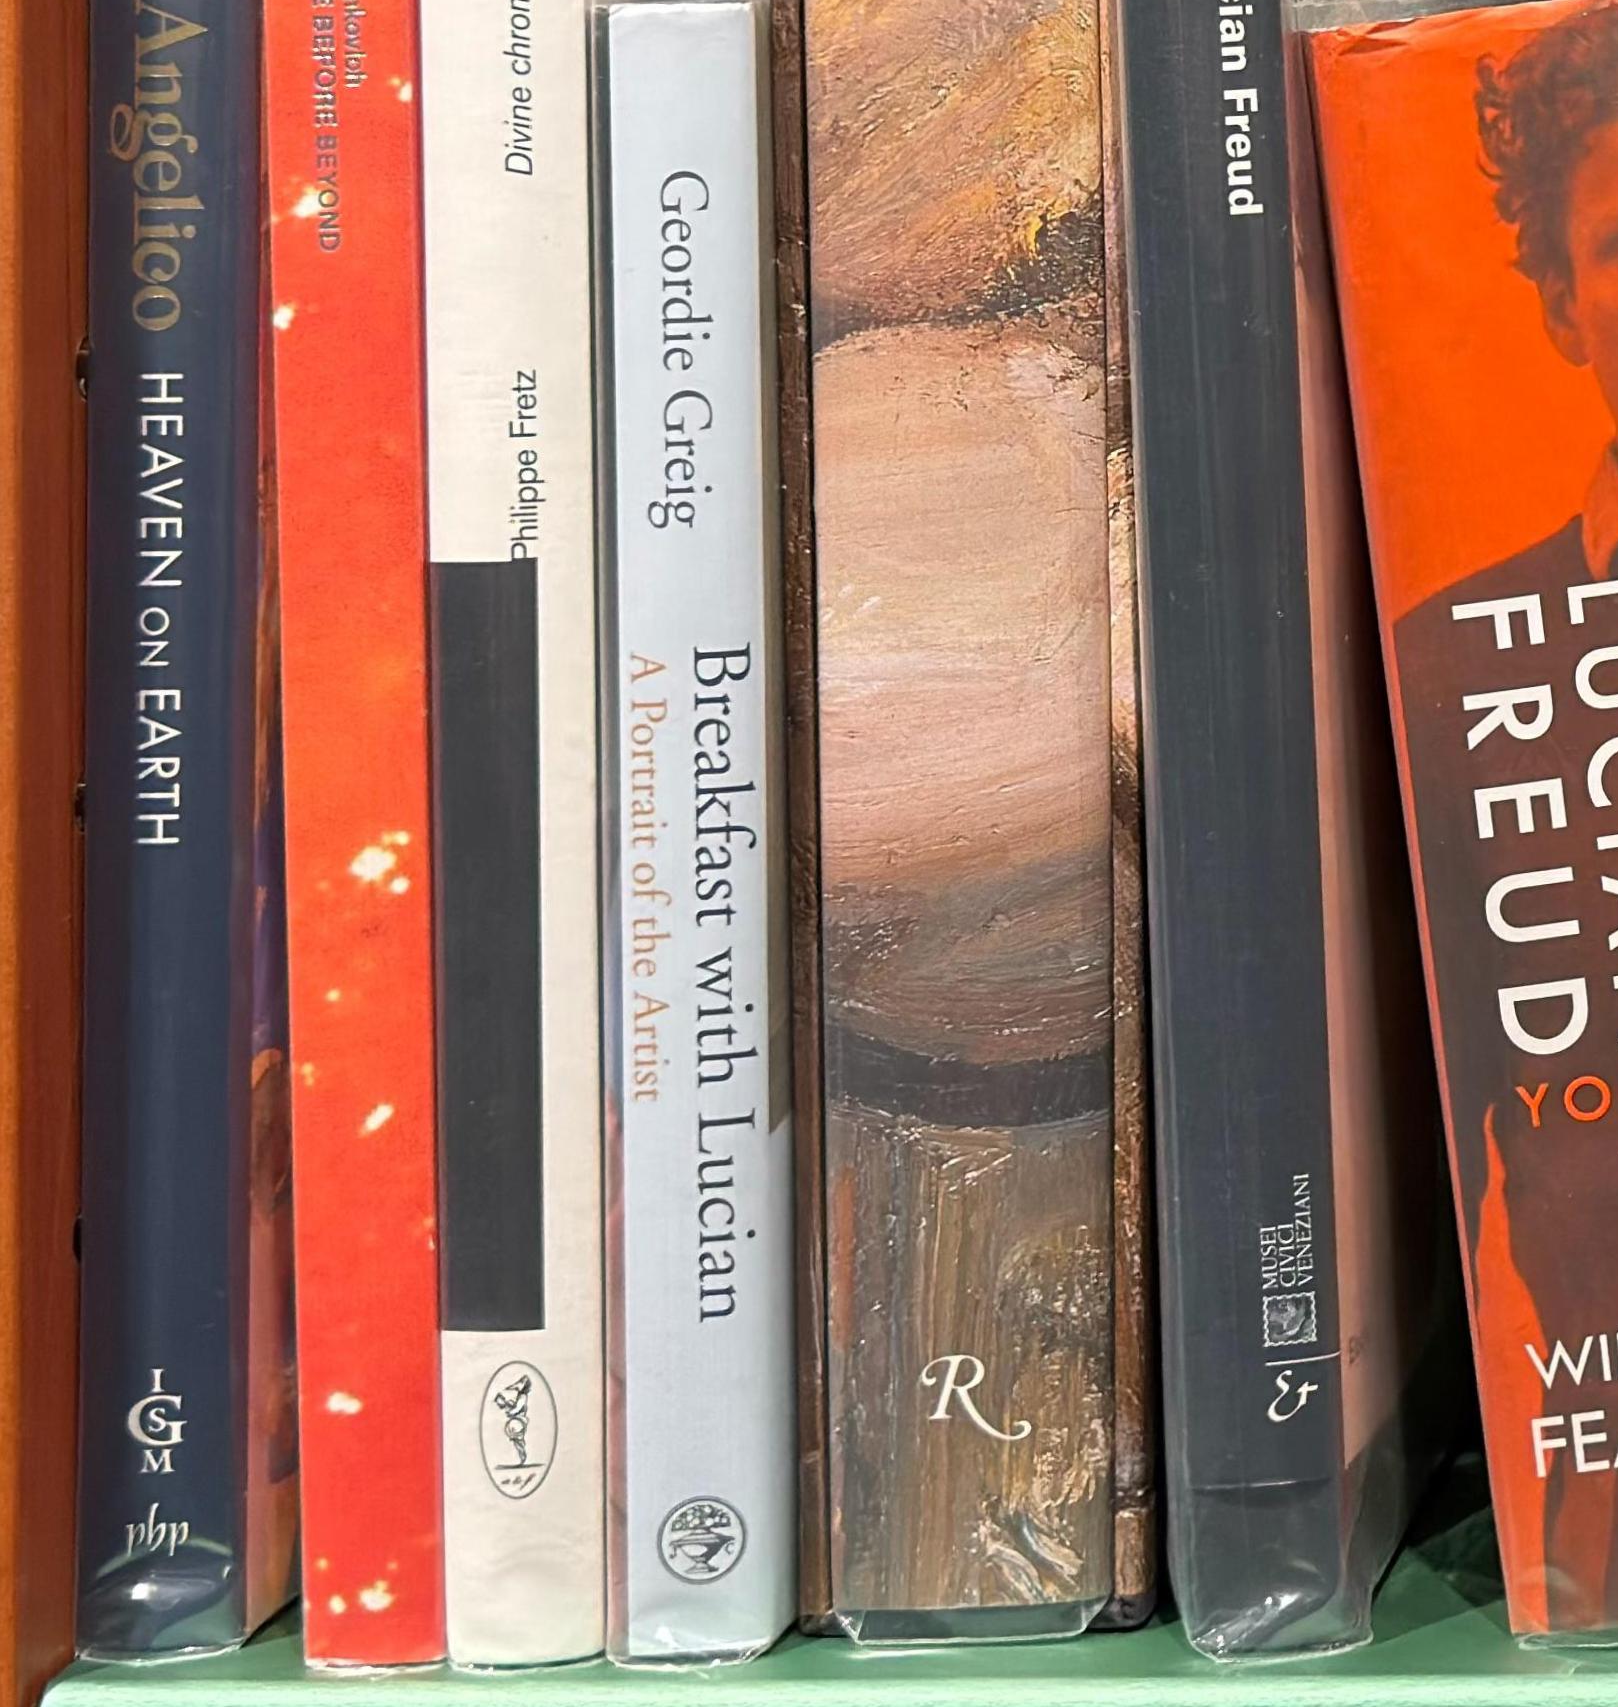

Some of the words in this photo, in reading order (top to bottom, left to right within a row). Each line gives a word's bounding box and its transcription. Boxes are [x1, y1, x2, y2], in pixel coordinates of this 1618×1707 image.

[311, 17, 339, 128] BEFORE
[502, 85, 534, 177] Divine
[1222, 88, 1264, 216] Freud
[316, 138, 341, 253] BEYOND
[660, 170, 714, 372] Geordie
[508, 369, 538, 439] Fretz
[647, 389, 714, 529] Greig
[138, 373, 184, 586] HEAVEN
[509, 449, 546, 562] Philippe
[138, 607, 170, 667] ON
[629, 652, 666, 683] A
[136, 689, 182, 844] EARTH
[628, 697, 669, 851] Portrait
[692, 642, 758, 929] Breakfast
[1451, 593, 1590, 1057] FREUD
[629, 860, 672, 908] of
[631, 911, 672, 977] the
[632, 992, 671, 1102] Artist
[695, 944, 760, 1088] with
[697, 1106, 758, 1324] Lucian
[1259, 1227, 1278, 1289] MUSEI
[1279, 1222, 1296, 1287] CIVICI
[1294, 1172, 1315, 1286] VENEZIANI
